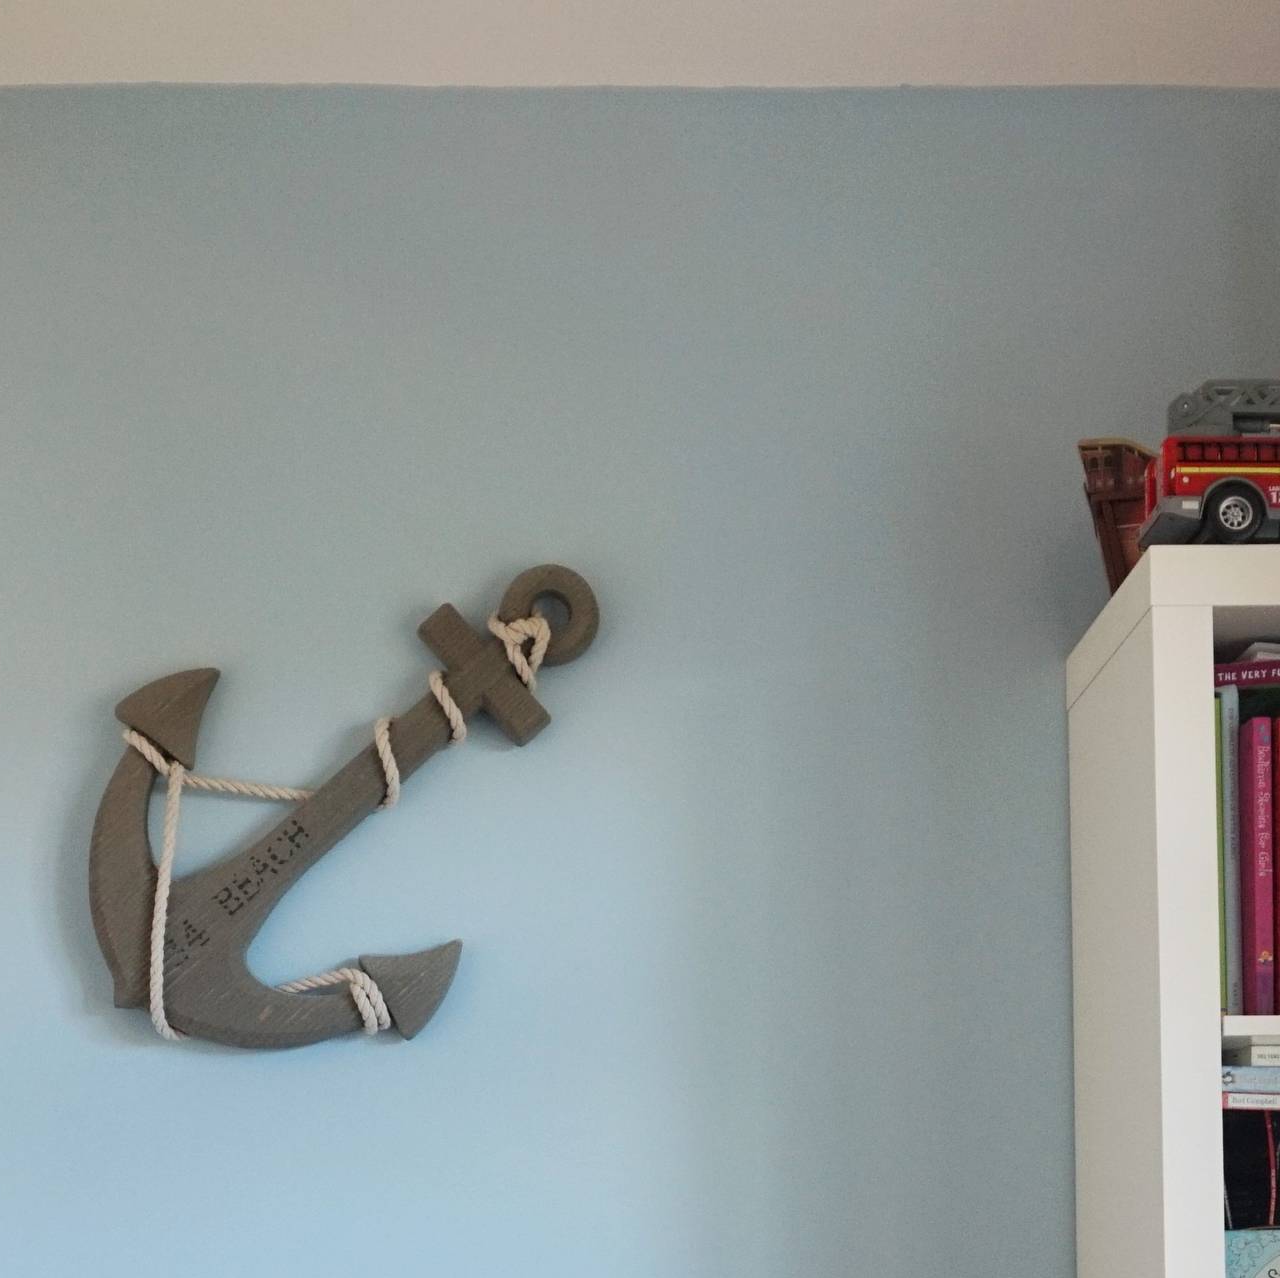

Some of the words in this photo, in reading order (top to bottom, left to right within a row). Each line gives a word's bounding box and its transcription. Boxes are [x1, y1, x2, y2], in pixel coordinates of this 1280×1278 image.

[1217, 671, 1238, 682] THE
[1241, 668, 1267, 680] VERY
[212, 819, 310, 916] BEACH
